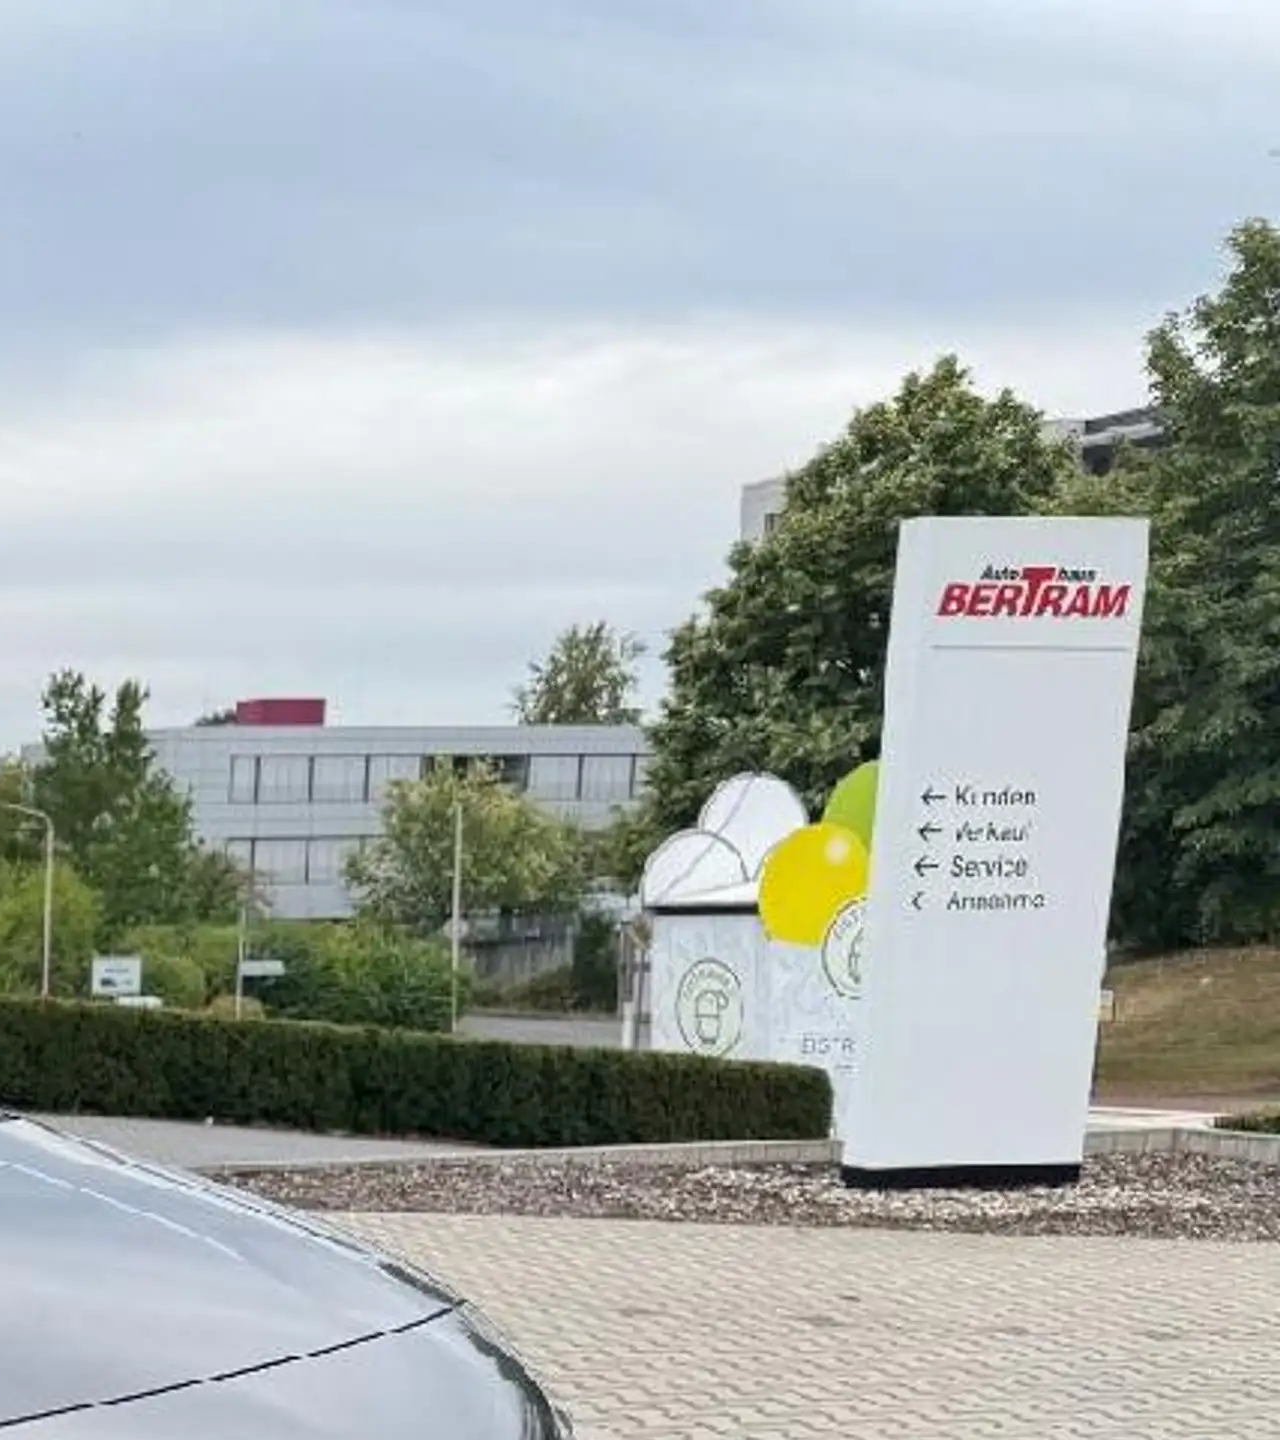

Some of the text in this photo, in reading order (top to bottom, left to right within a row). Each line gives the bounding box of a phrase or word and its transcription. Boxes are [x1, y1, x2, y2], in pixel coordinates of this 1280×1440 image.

[980, 564, 1098, 582] Auto haus
[937, 566, 1133, 618] BERTRAM
